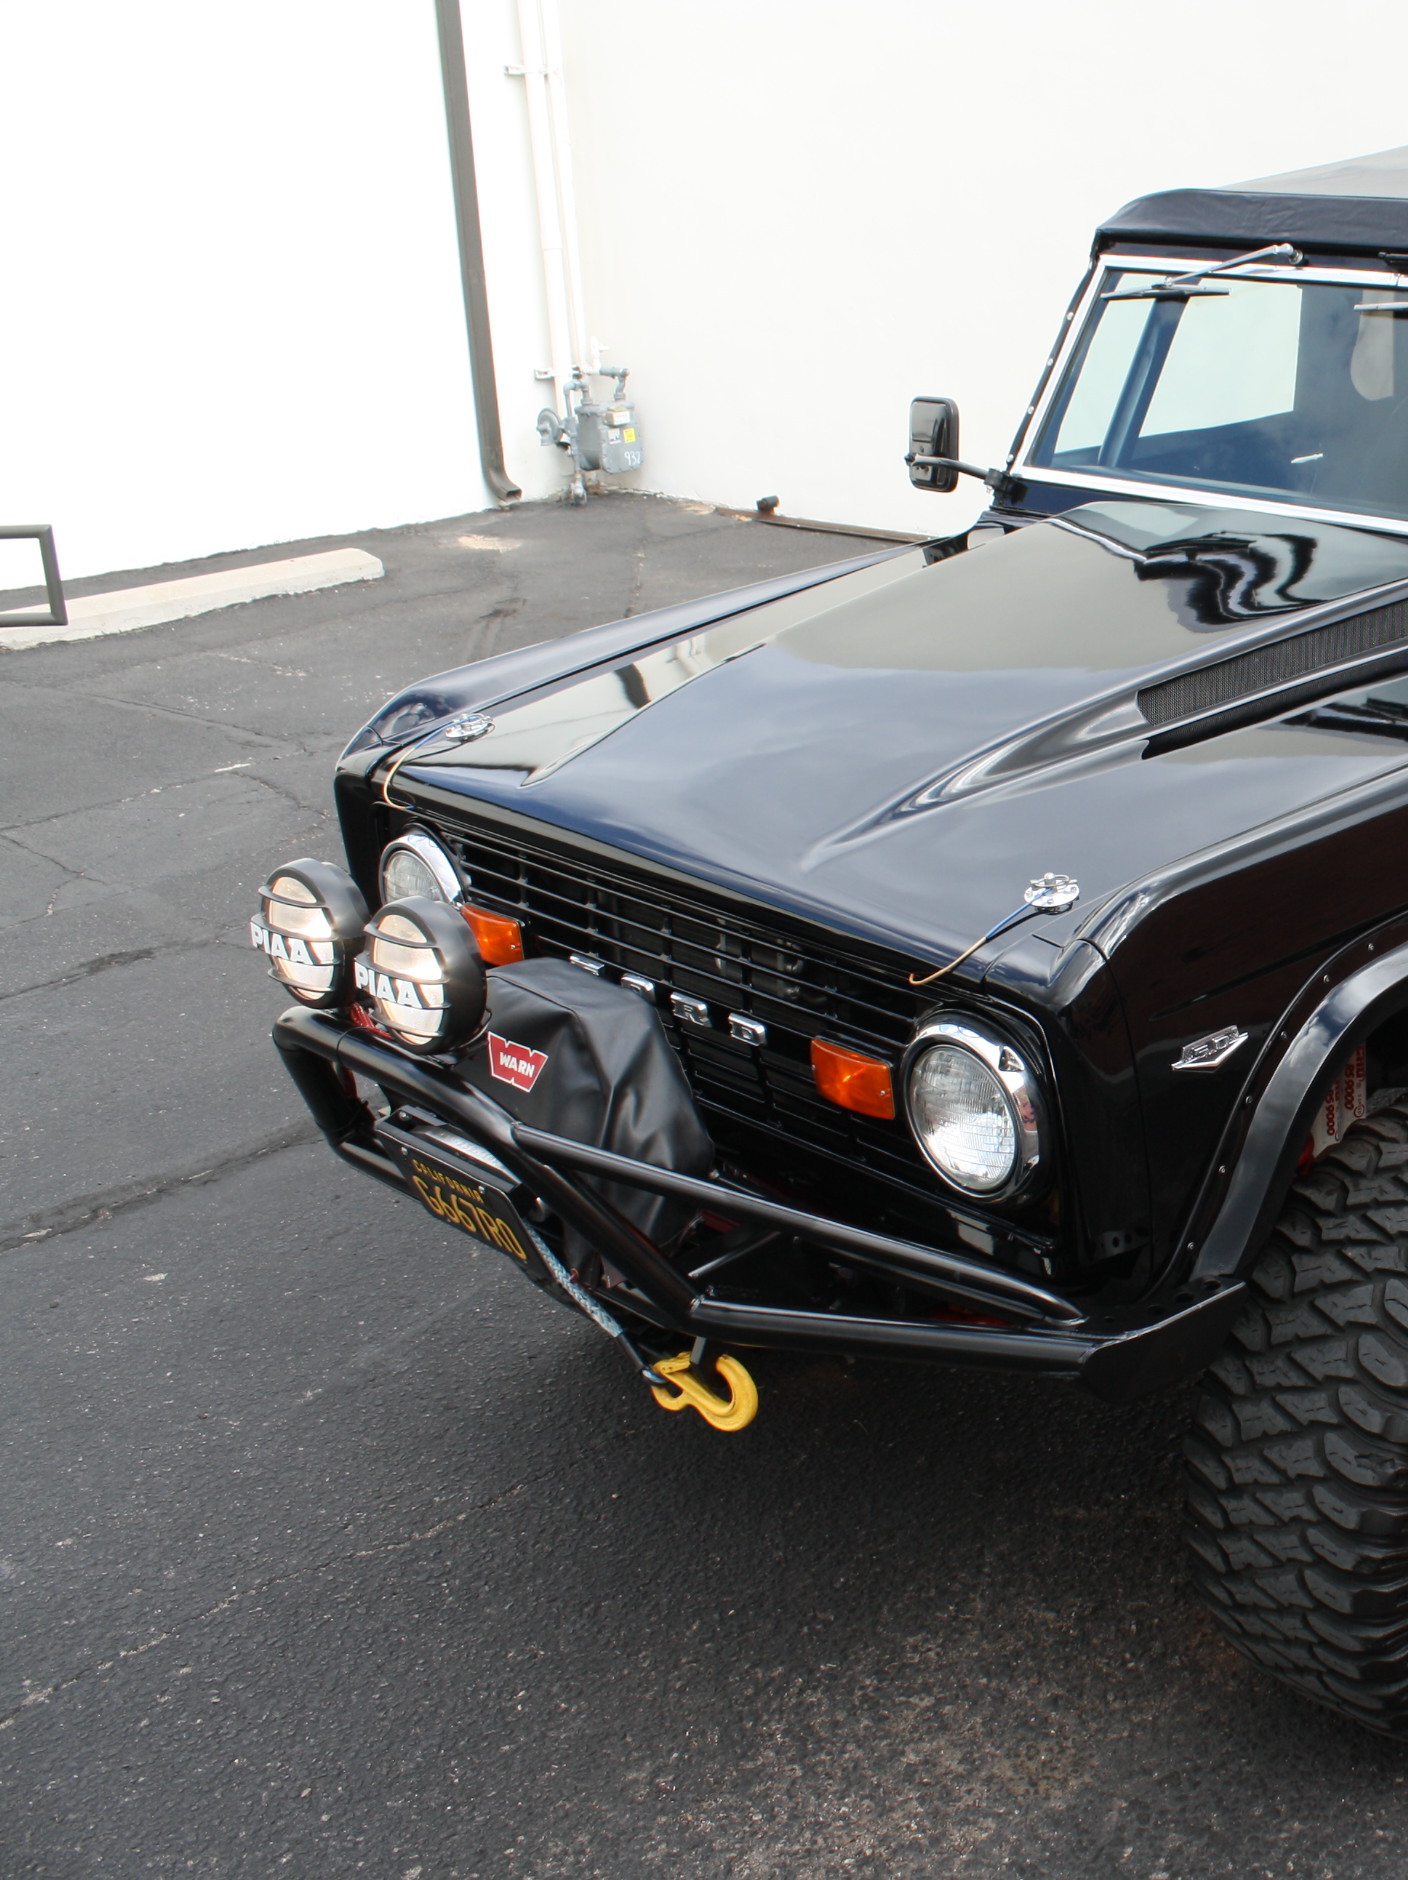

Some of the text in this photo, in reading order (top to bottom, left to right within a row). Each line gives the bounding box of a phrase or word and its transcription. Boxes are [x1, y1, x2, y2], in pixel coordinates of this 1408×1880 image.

[250, 922, 315, 966] PIAA
[354, 961, 423, 1010] PIAA
[499, 1051, 536, 1079] WARN
